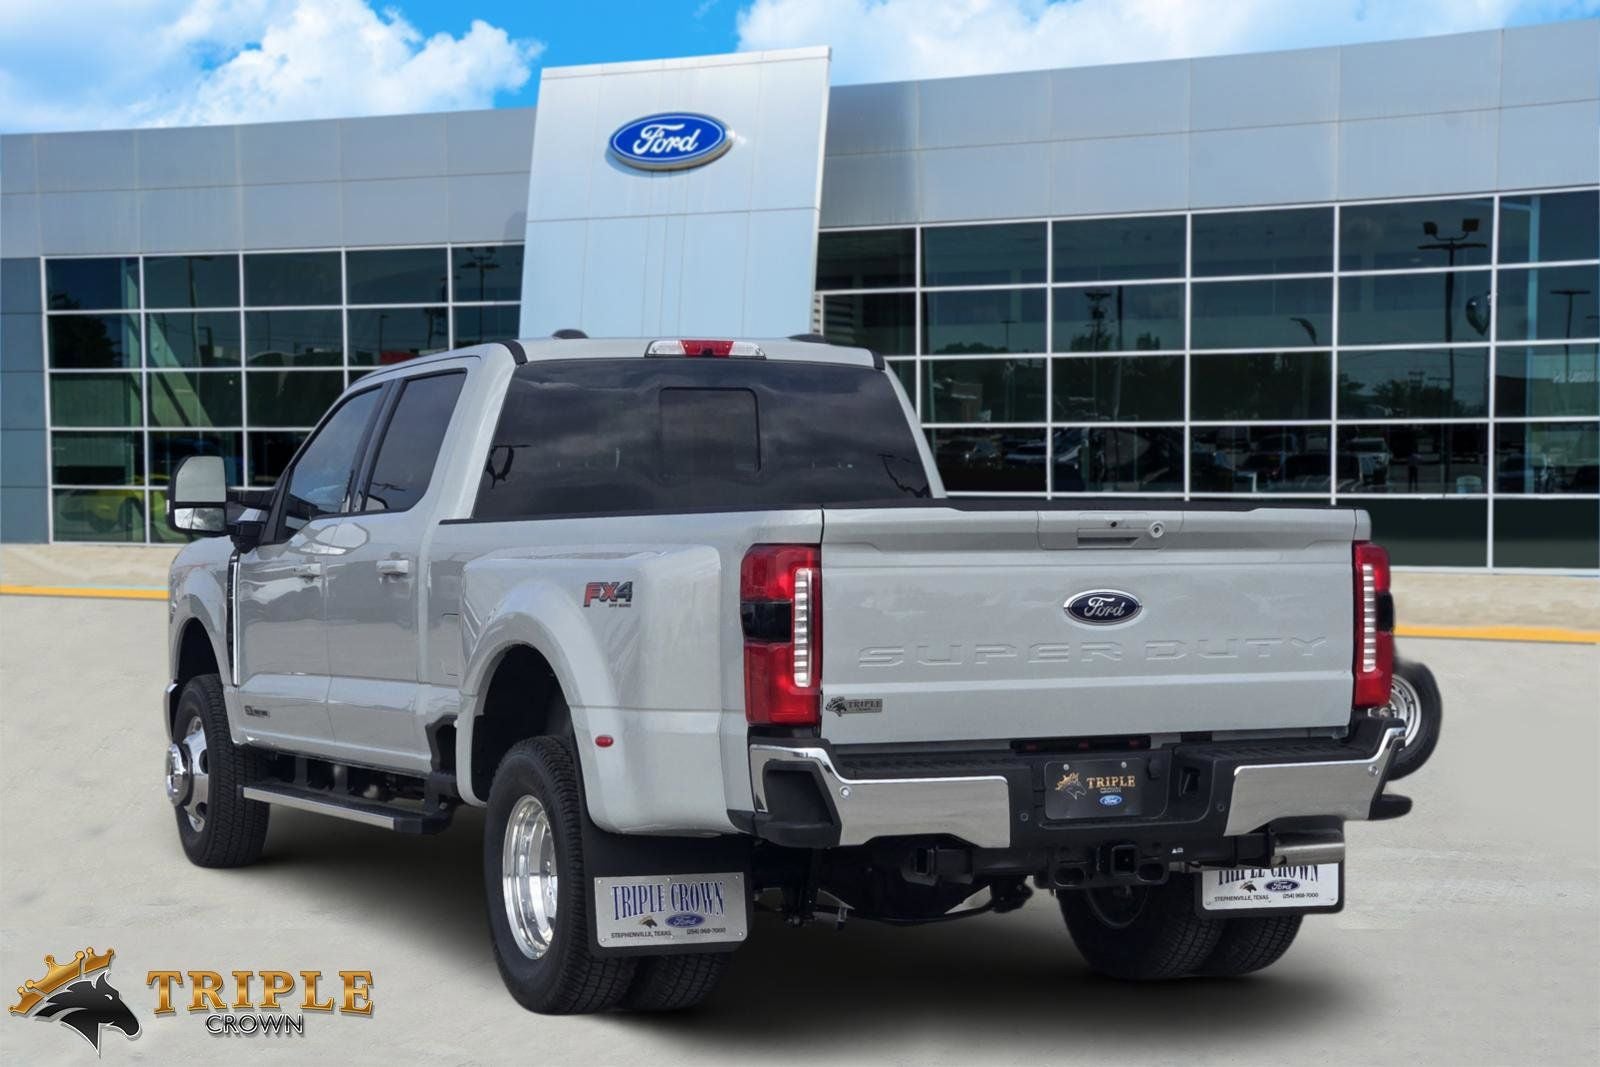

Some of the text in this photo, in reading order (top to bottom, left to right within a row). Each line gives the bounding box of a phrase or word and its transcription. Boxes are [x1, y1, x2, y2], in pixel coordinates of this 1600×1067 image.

[632, 123, 702, 155] Ford
[583, 581, 633, 608] FX4
[1084, 596, 1126, 617] Ford
[859, 636, 1328, 668] SUPER DUTY
[847, 700, 882, 709] TRIPLE
[1086, 775, 1136, 789] TRIPLE
[1270, 880, 1293, 891] Ford
[611, 881, 725, 920] TRIPLE CROWN
[672, 915, 698, 927] Ford
